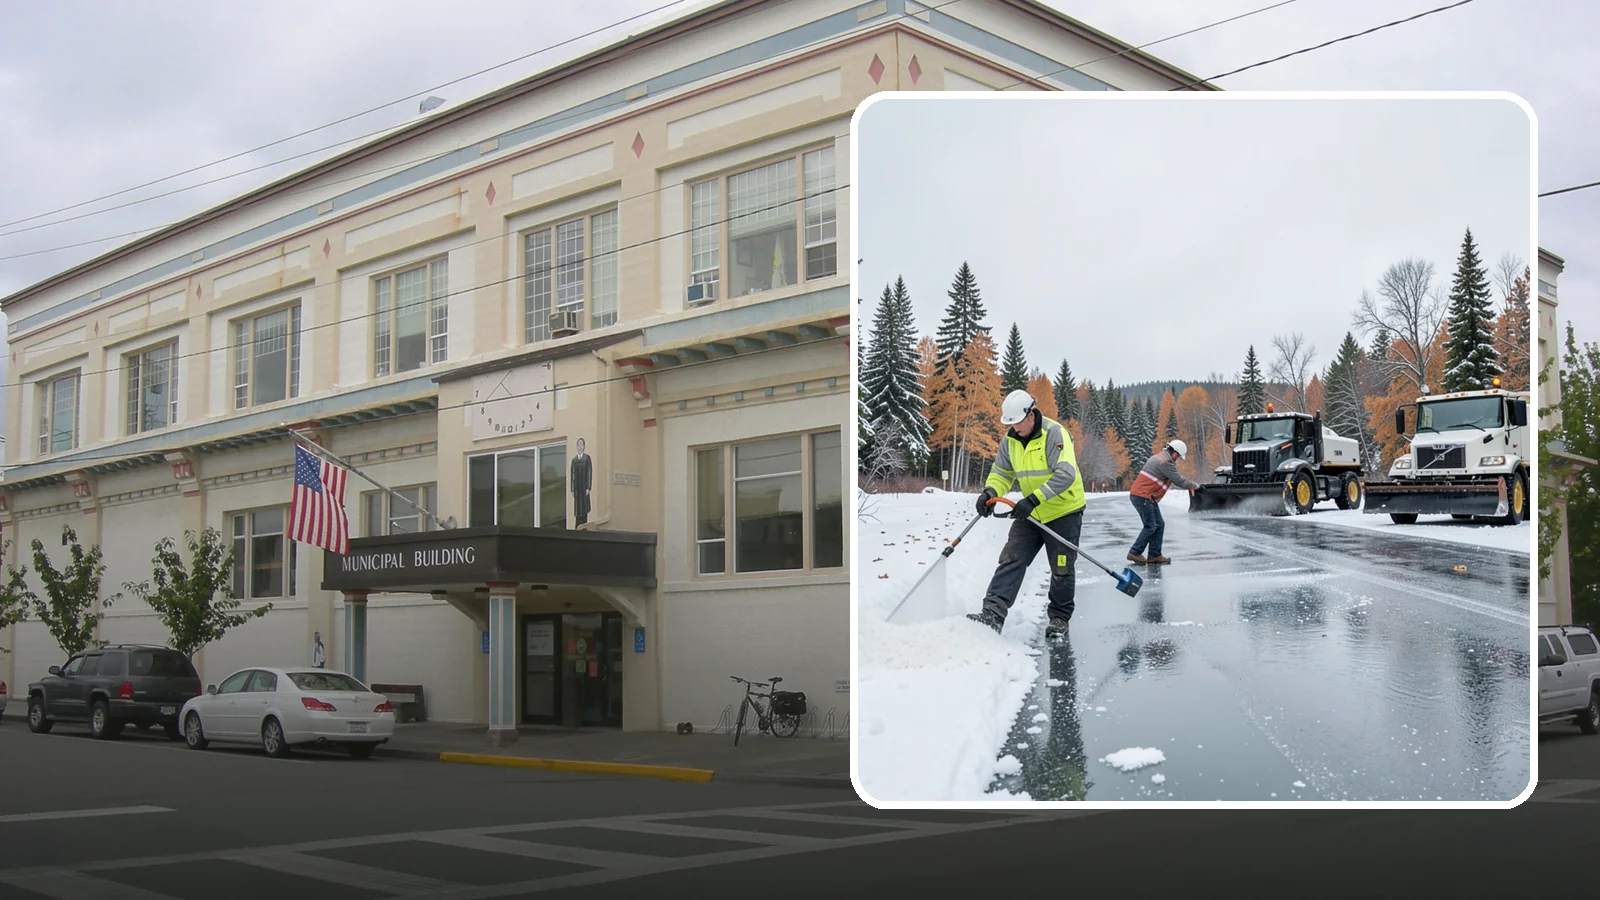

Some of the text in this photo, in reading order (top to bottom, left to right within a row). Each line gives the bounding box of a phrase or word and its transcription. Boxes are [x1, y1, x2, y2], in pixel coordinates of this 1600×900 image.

[475, 390, 479, 398] 7
[536, 402, 540, 410] 4
[480, 407, 485, 415] 8
[488, 417, 492, 426] 9
[528, 413, 533, 422] 3
[521, 420, 525, 428] 2
[342, 546, 475, 572] MUNICIPAL BUILDING
